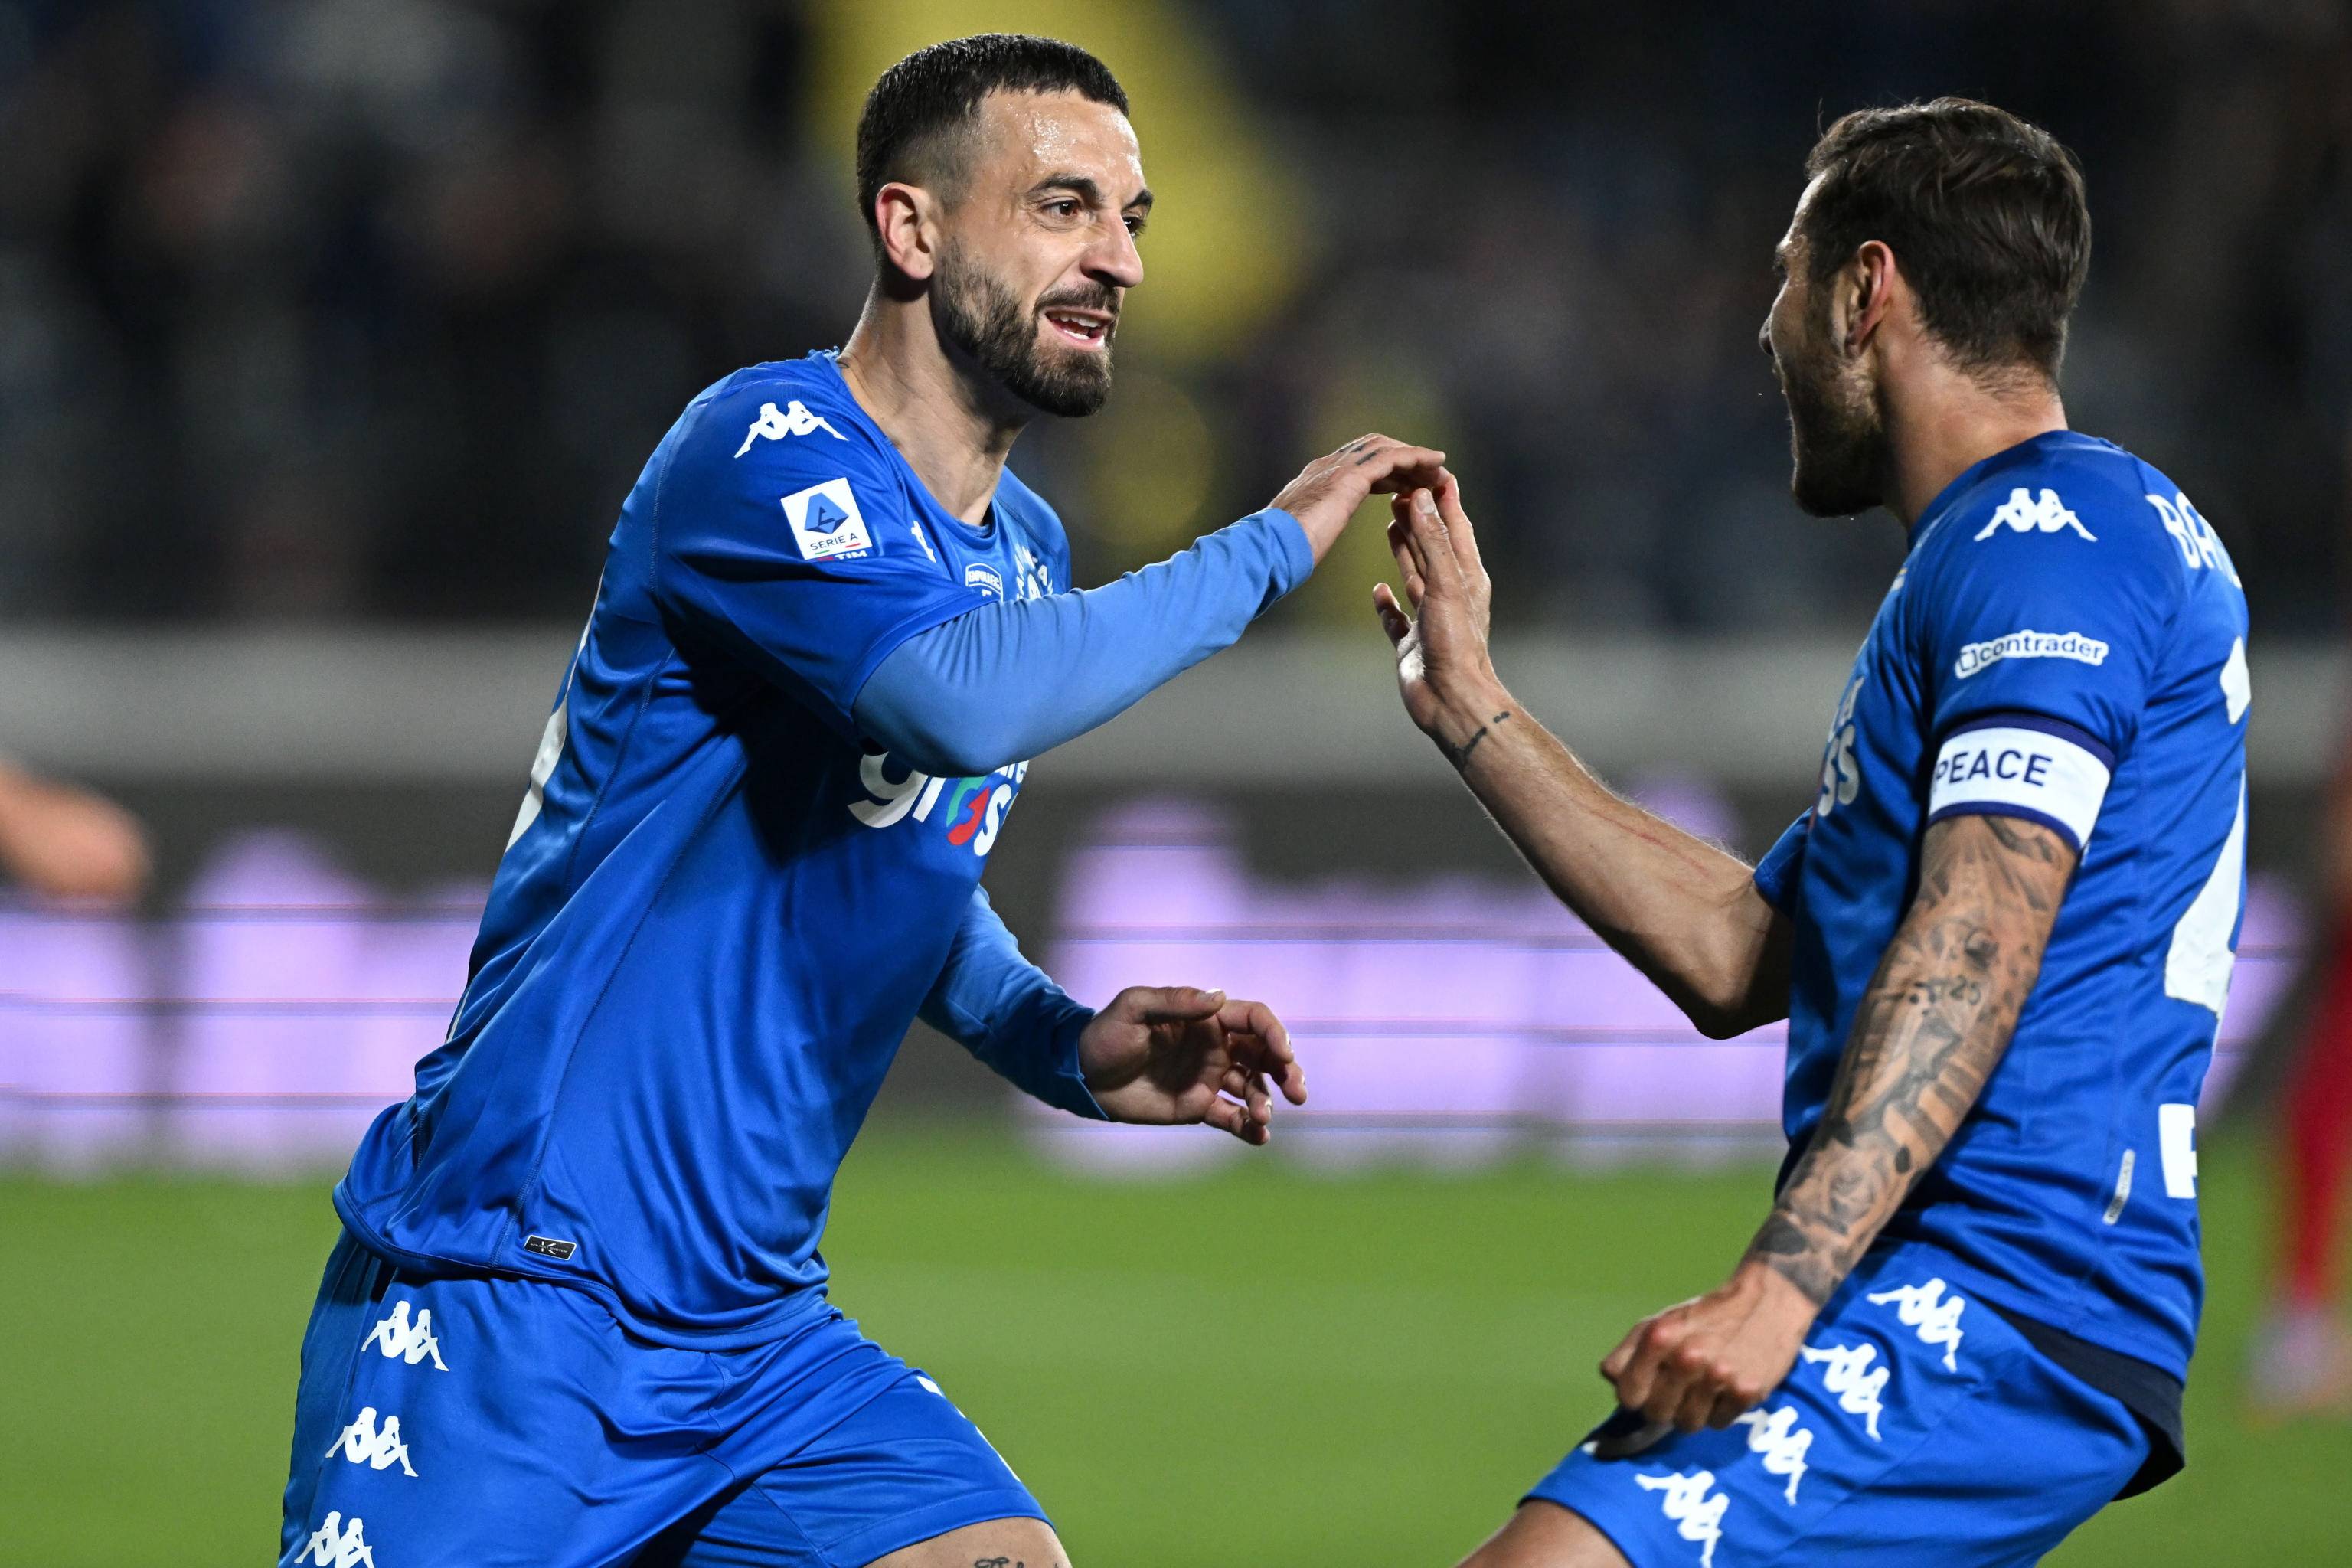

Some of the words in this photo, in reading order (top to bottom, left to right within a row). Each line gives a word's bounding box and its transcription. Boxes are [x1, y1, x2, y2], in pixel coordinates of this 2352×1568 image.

[809, 535, 846, 550] SERIE
[849, 532, 858, 541] A
[834, 550, 868, 560] TIM
[1979, 635, 2103, 659] contrader
[1935, 748, 2053, 787] PEACE
